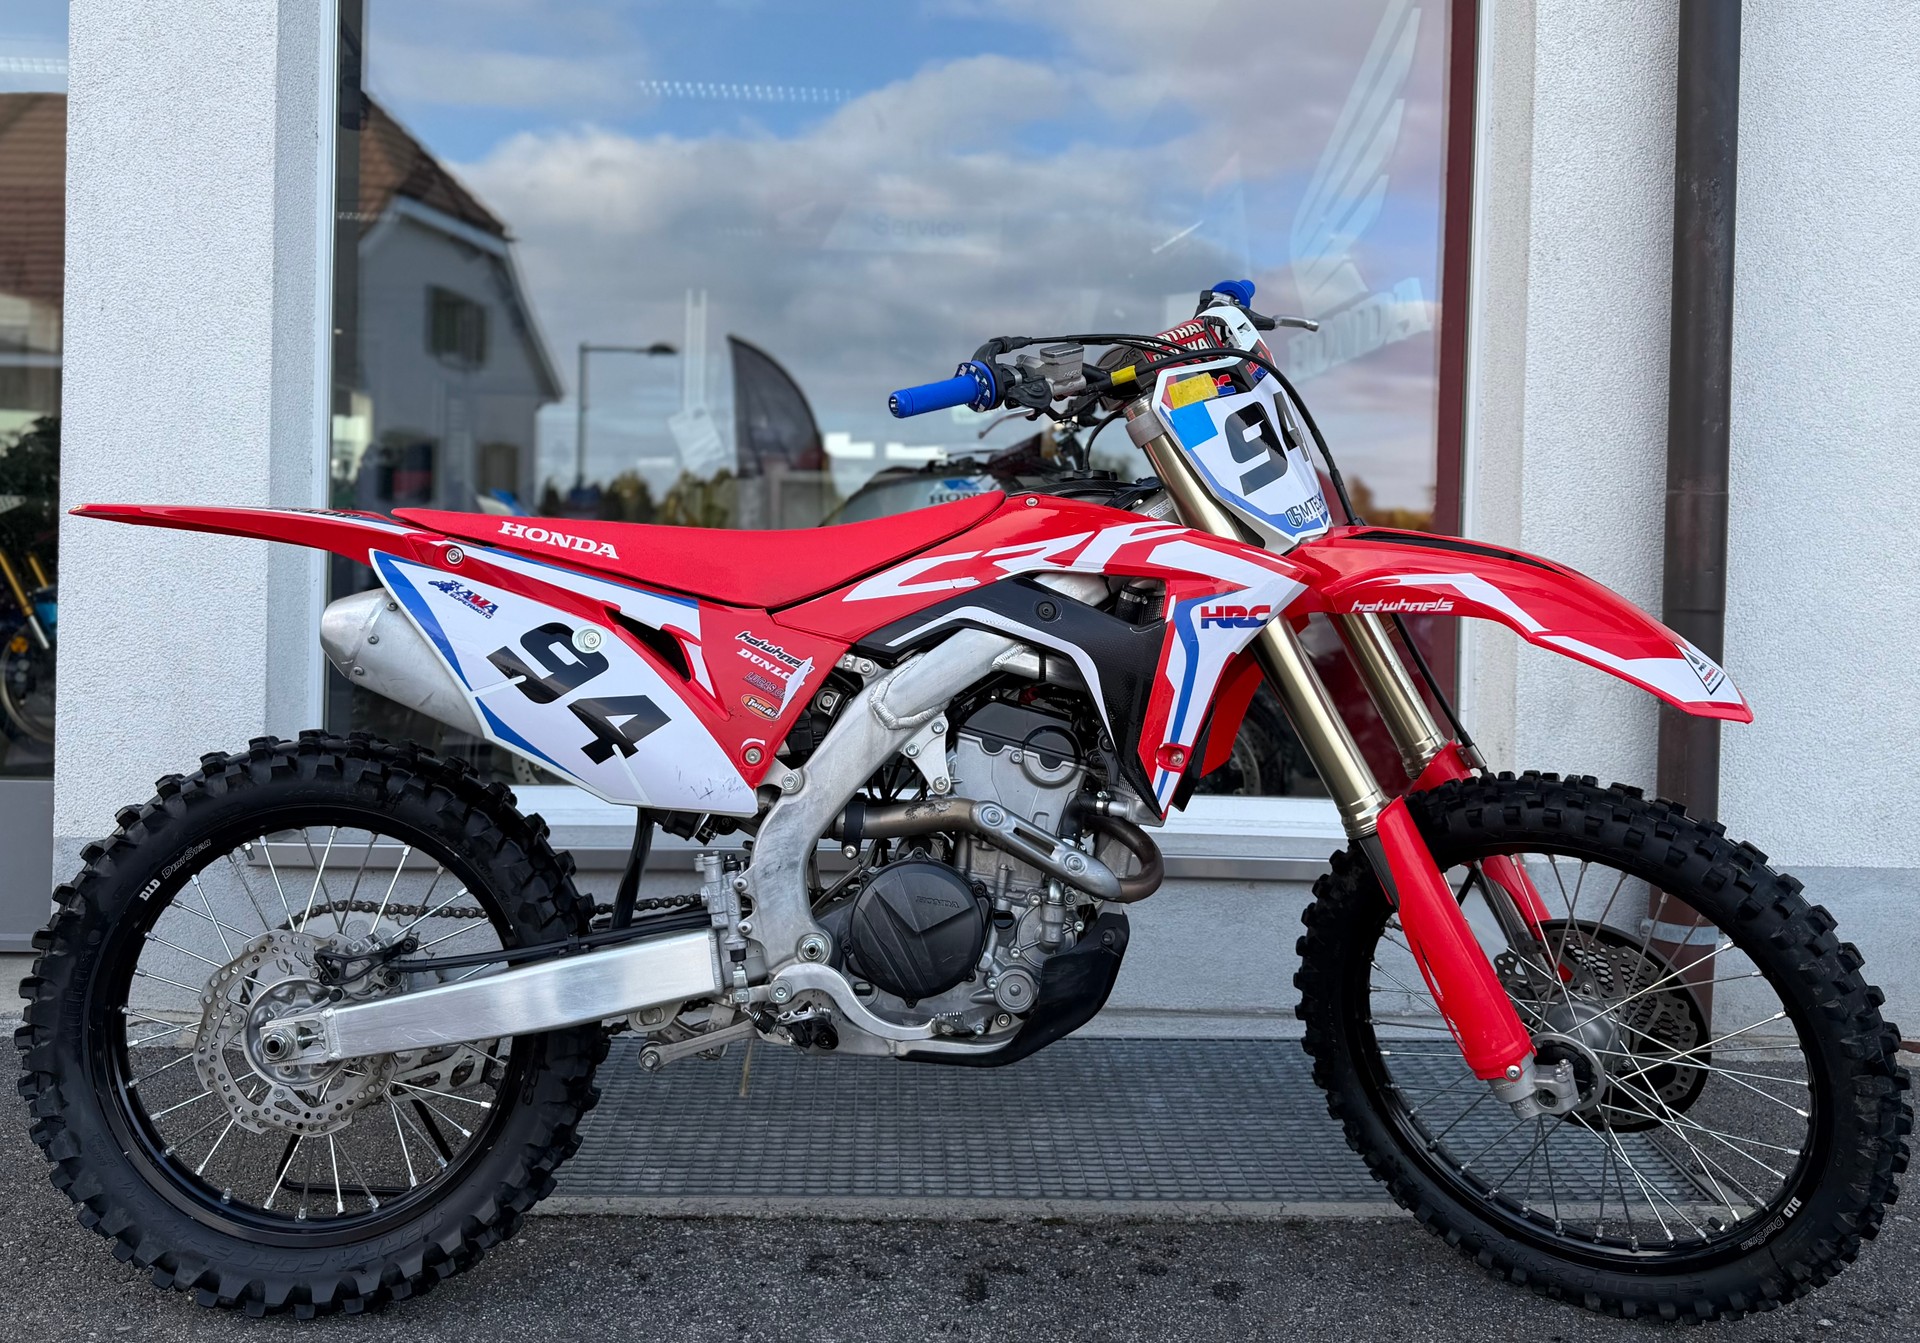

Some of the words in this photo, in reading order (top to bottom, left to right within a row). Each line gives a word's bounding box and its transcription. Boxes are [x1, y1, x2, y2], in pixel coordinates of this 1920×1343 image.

[1224, 392, 1309, 497] 94
[499, 521, 620, 560] HONDA
[449, 592, 493, 619] SUPERMOTO
[453, 589, 499, 616] AMA
[1351, 597, 1454, 612] hotwheels
[1201, 605, 1271, 629] HRC
[736, 648, 805, 686] DUNLO
[486, 622, 672, 765] 94
[915, 895, 960, 908] HONDA
